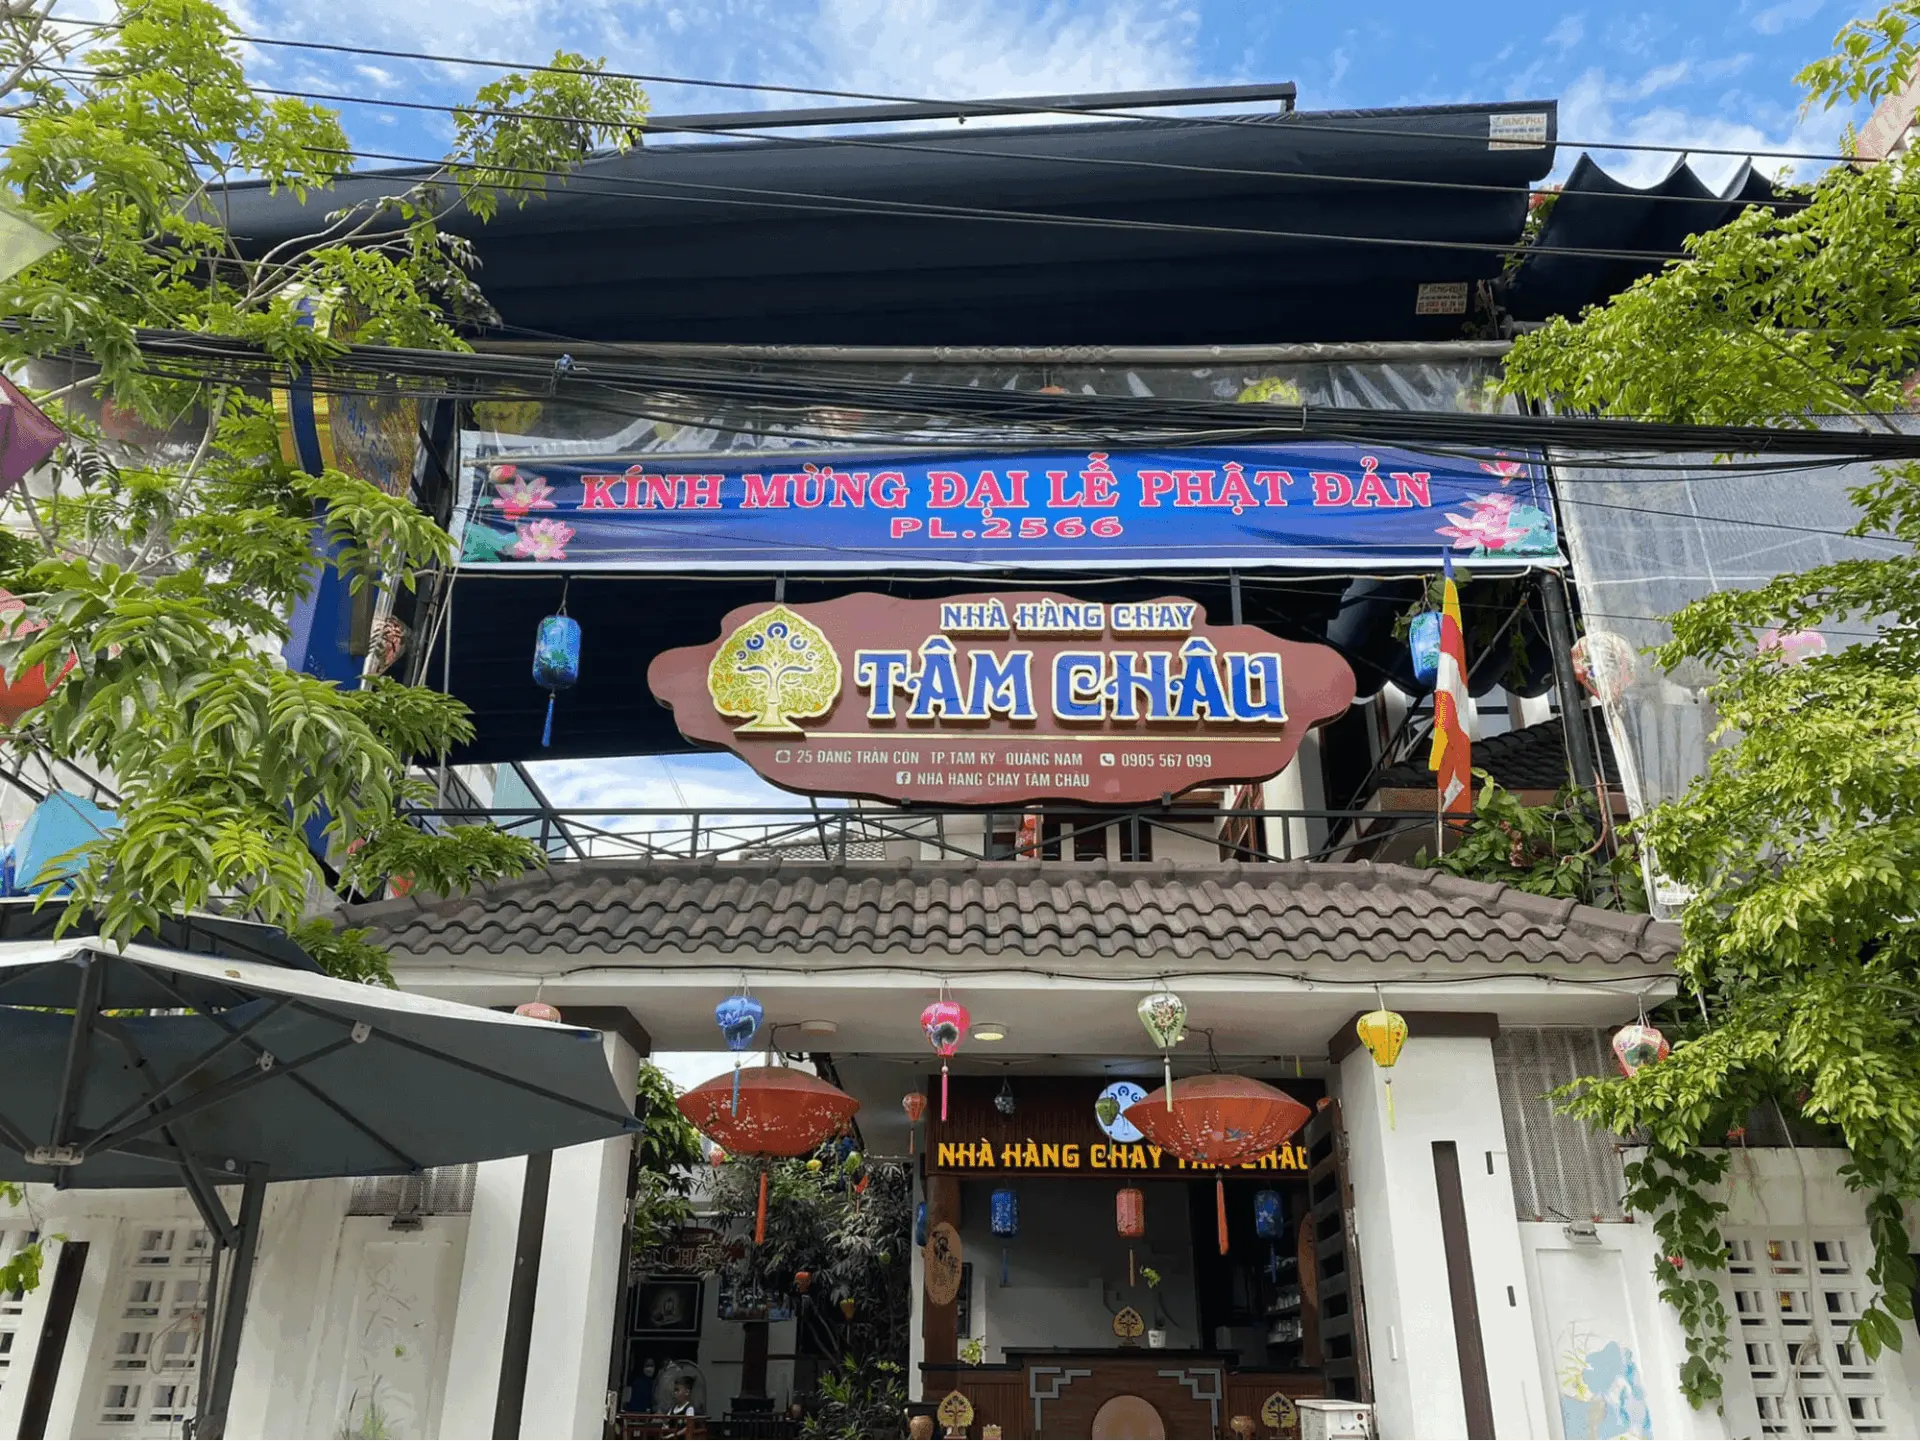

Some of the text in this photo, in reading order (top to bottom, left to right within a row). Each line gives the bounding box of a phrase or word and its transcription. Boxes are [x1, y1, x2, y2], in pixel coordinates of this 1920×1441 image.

[576, 452, 1432, 518] KÍNH MỪNG ĐẠI LỄ PHẬT ĐẢN
[890, 516, 1124, 539] PL.2566
[940, 598, 1197, 632] NHÀ HÀNG CHAY
[854, 634, 1288, 722] TÂM CHÂU
[796, 749, 813, 764] 25
[1054, 753, 1084, 767] NAM
[1121, 753, 1212, 768] 0905 567 099
[987, 772, 1020, 786] CHAY
[937, 1138, 995, 1168] NHÀ
[1003, 1138, 1080, 1168] HÀNG
[1090, 1142, 1162, 1169] CHAY
